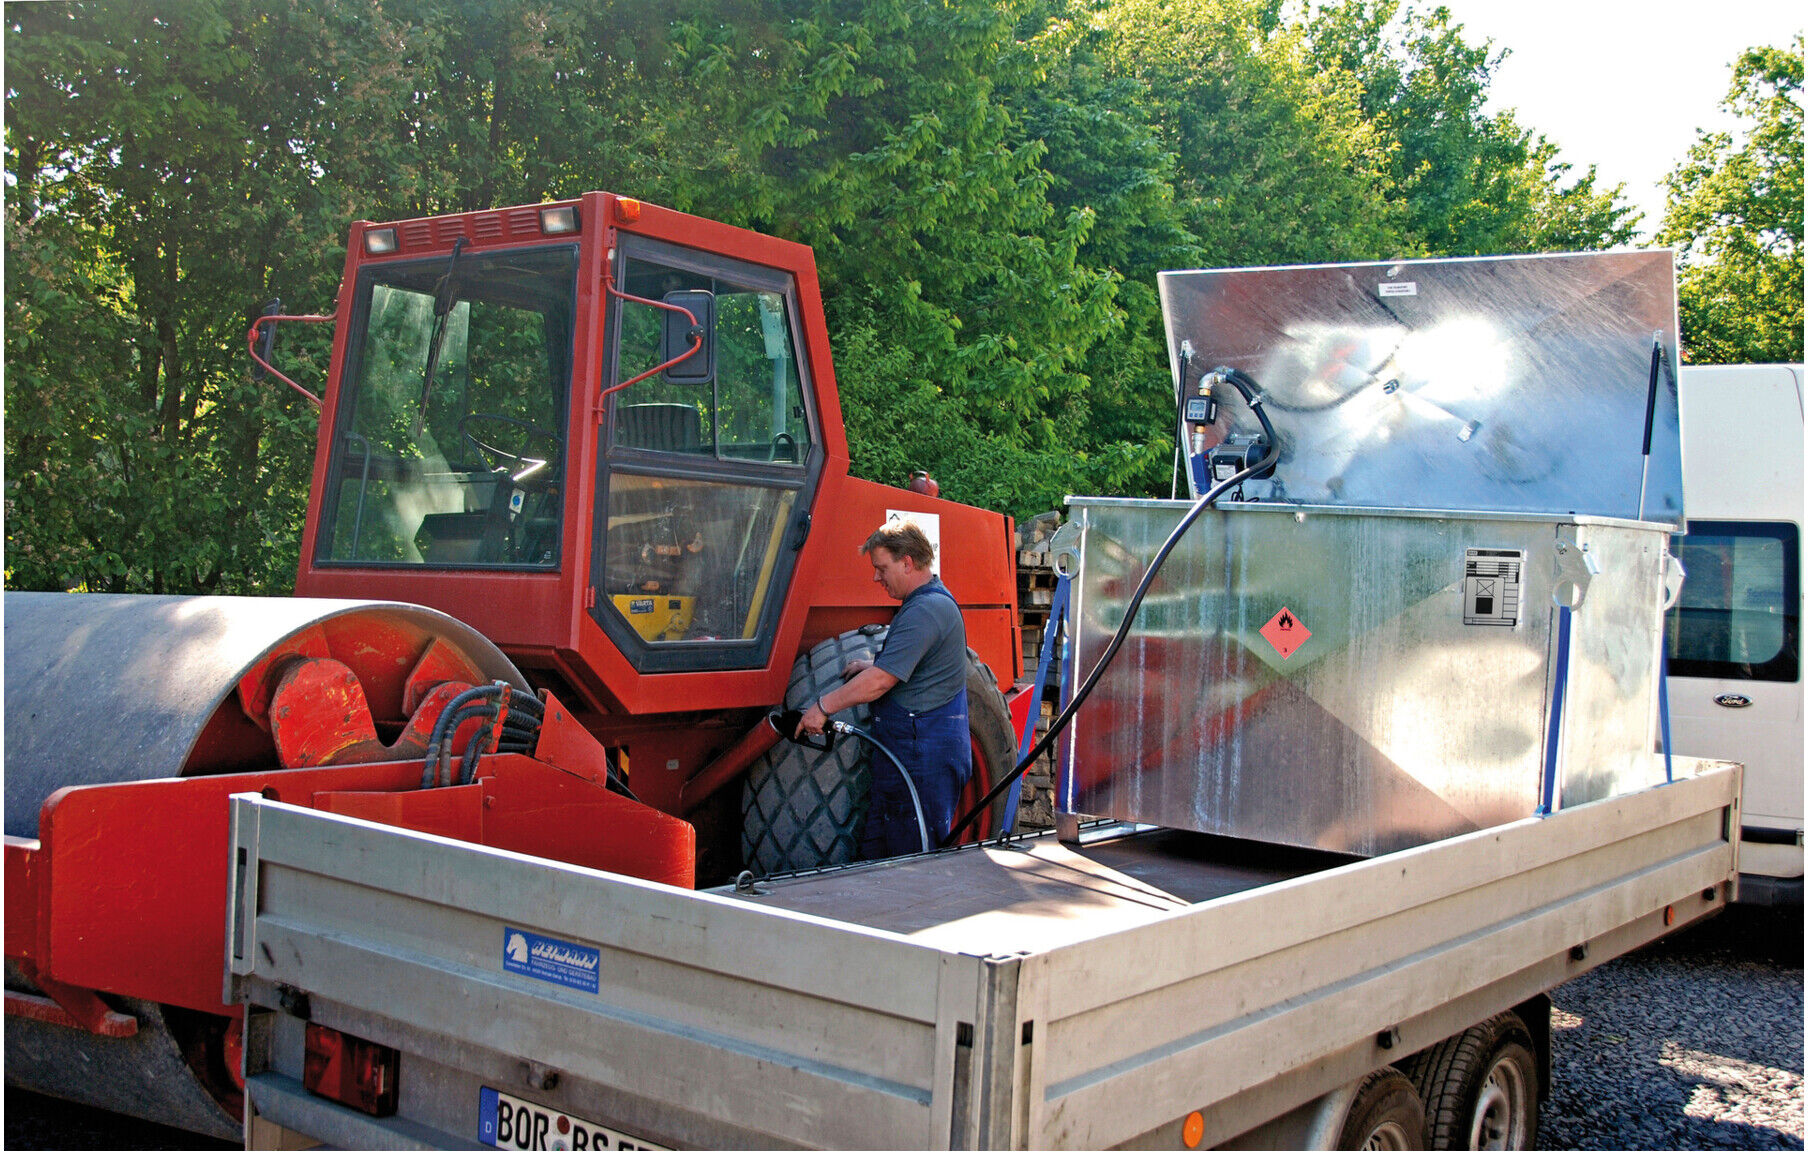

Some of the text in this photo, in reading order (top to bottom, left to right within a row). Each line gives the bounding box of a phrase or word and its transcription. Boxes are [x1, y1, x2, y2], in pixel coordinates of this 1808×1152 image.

[1721, 695, 1744, 705] Ford
[531, 941, 598, 970] HEIMANN
[485, 1121, 492, 1134] D
[498, 1100, 550, 1151] BOR
